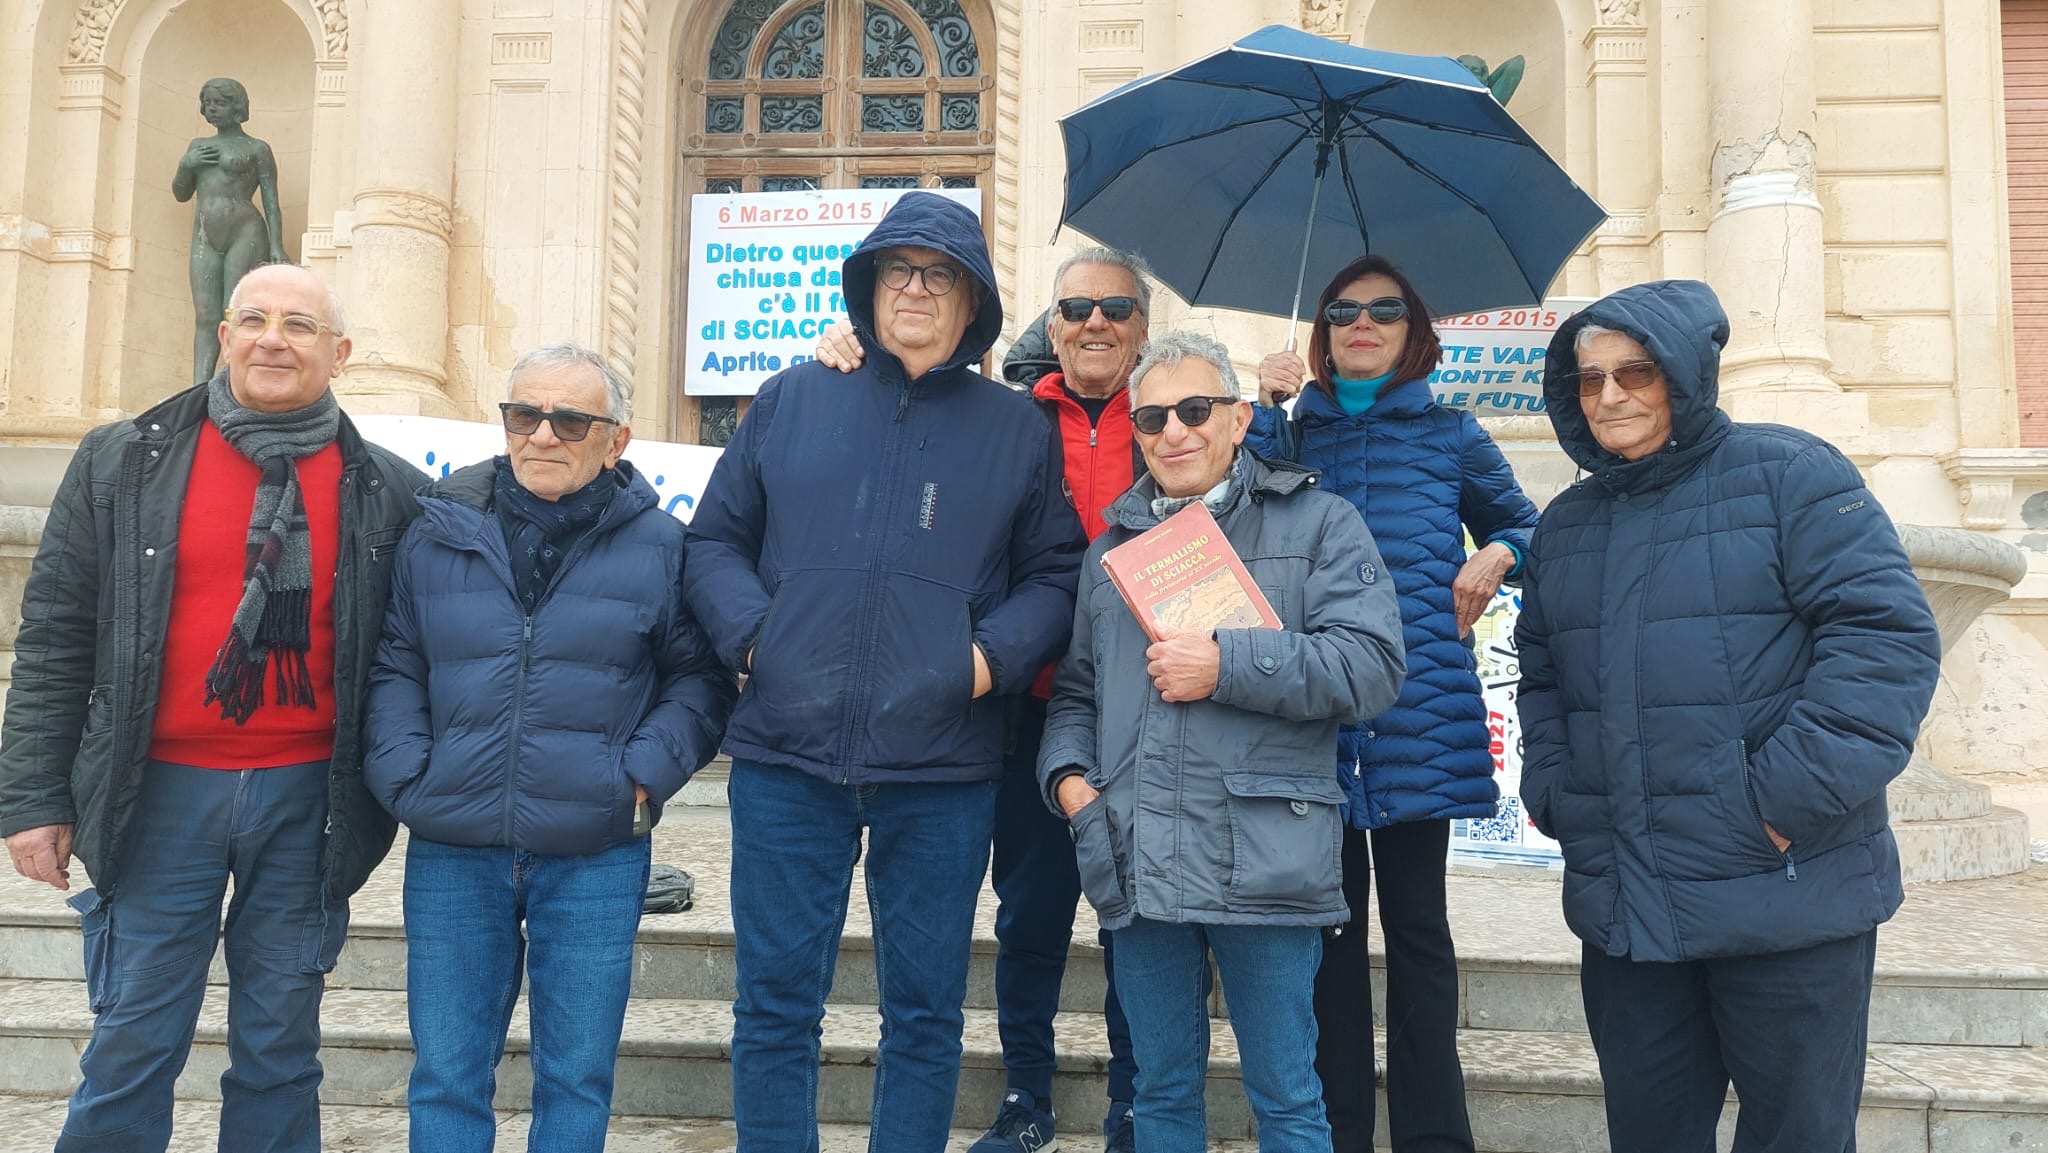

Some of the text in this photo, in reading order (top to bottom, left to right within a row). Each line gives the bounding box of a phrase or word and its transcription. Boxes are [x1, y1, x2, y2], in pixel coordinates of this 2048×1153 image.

[719, 207, 730, 223] 6
[740, 205, 809, 222] Marzo
[818, 202, 872, 220] 2015
[706, 243, 783, 263] Dietro
[717, 267, 802, 289] chiusa
[759, 292, 796, 313] c'è
[806, 292, 820, 313] il
[1498, 310, 1557, 327] 2015
[702, 320, 725, 340] di
[702, 351, 782, 377] Aprite
[1492, 346, 1546, 364] VAP
[1427, 369, 1545, 385] MONTE K
[1435, 391, 1547, 412] LE FUTU
[1133, 570, 1146, 583] IL
[1144, 535, 1209, 576] TERMALISMO
[1150, 552, 1206, 588] DI SCIACCA
[1488, 710, 1504, 772] 2027
